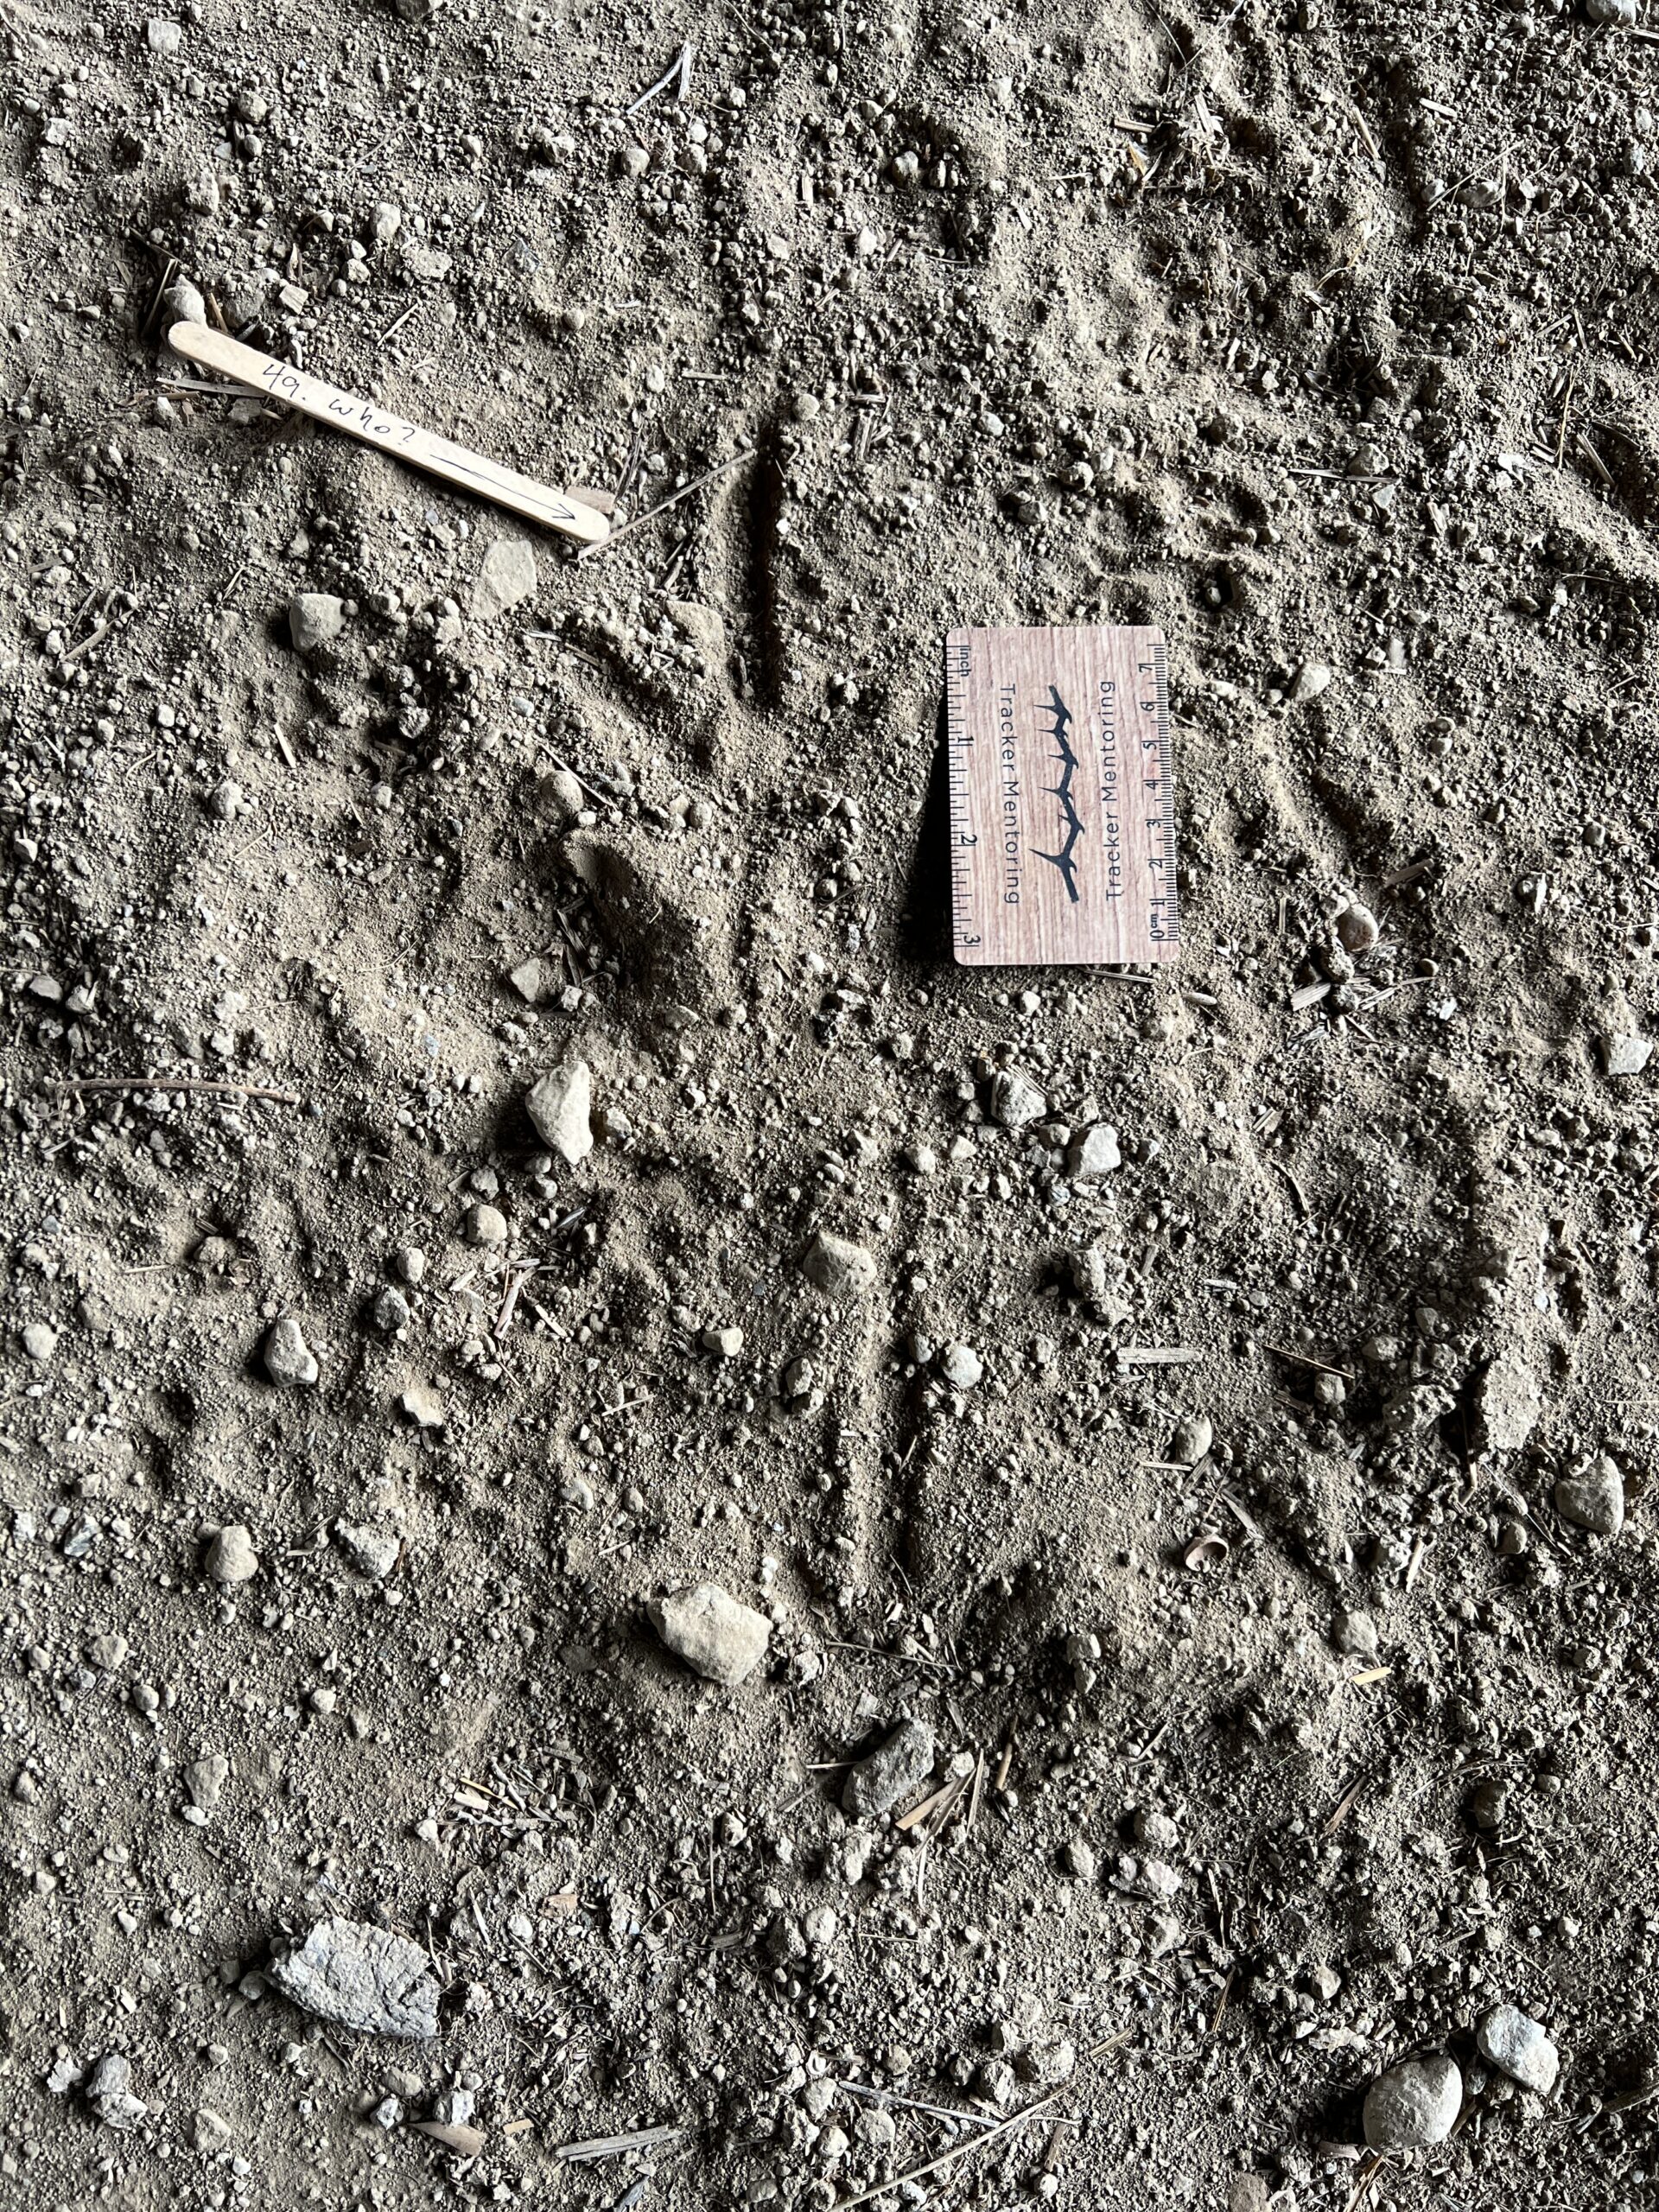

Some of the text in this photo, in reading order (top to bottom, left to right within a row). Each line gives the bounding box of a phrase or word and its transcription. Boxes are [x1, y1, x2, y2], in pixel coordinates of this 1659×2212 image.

[959, 647, 972, 677] inch
[1141, 702, 1155, 712] 6
[1142, 742, 1157, 751] 5
[1098, 681, 1122, 901] Tracker Mentoring
[1146, 781, 1159, 791] 4
[1000, 683, 1022, 904] Tracker Mentoring
[960, 834, 978, 845] 2
[1148, 861, 1163, 869] 2
[963, 934, 982, 944] 3
